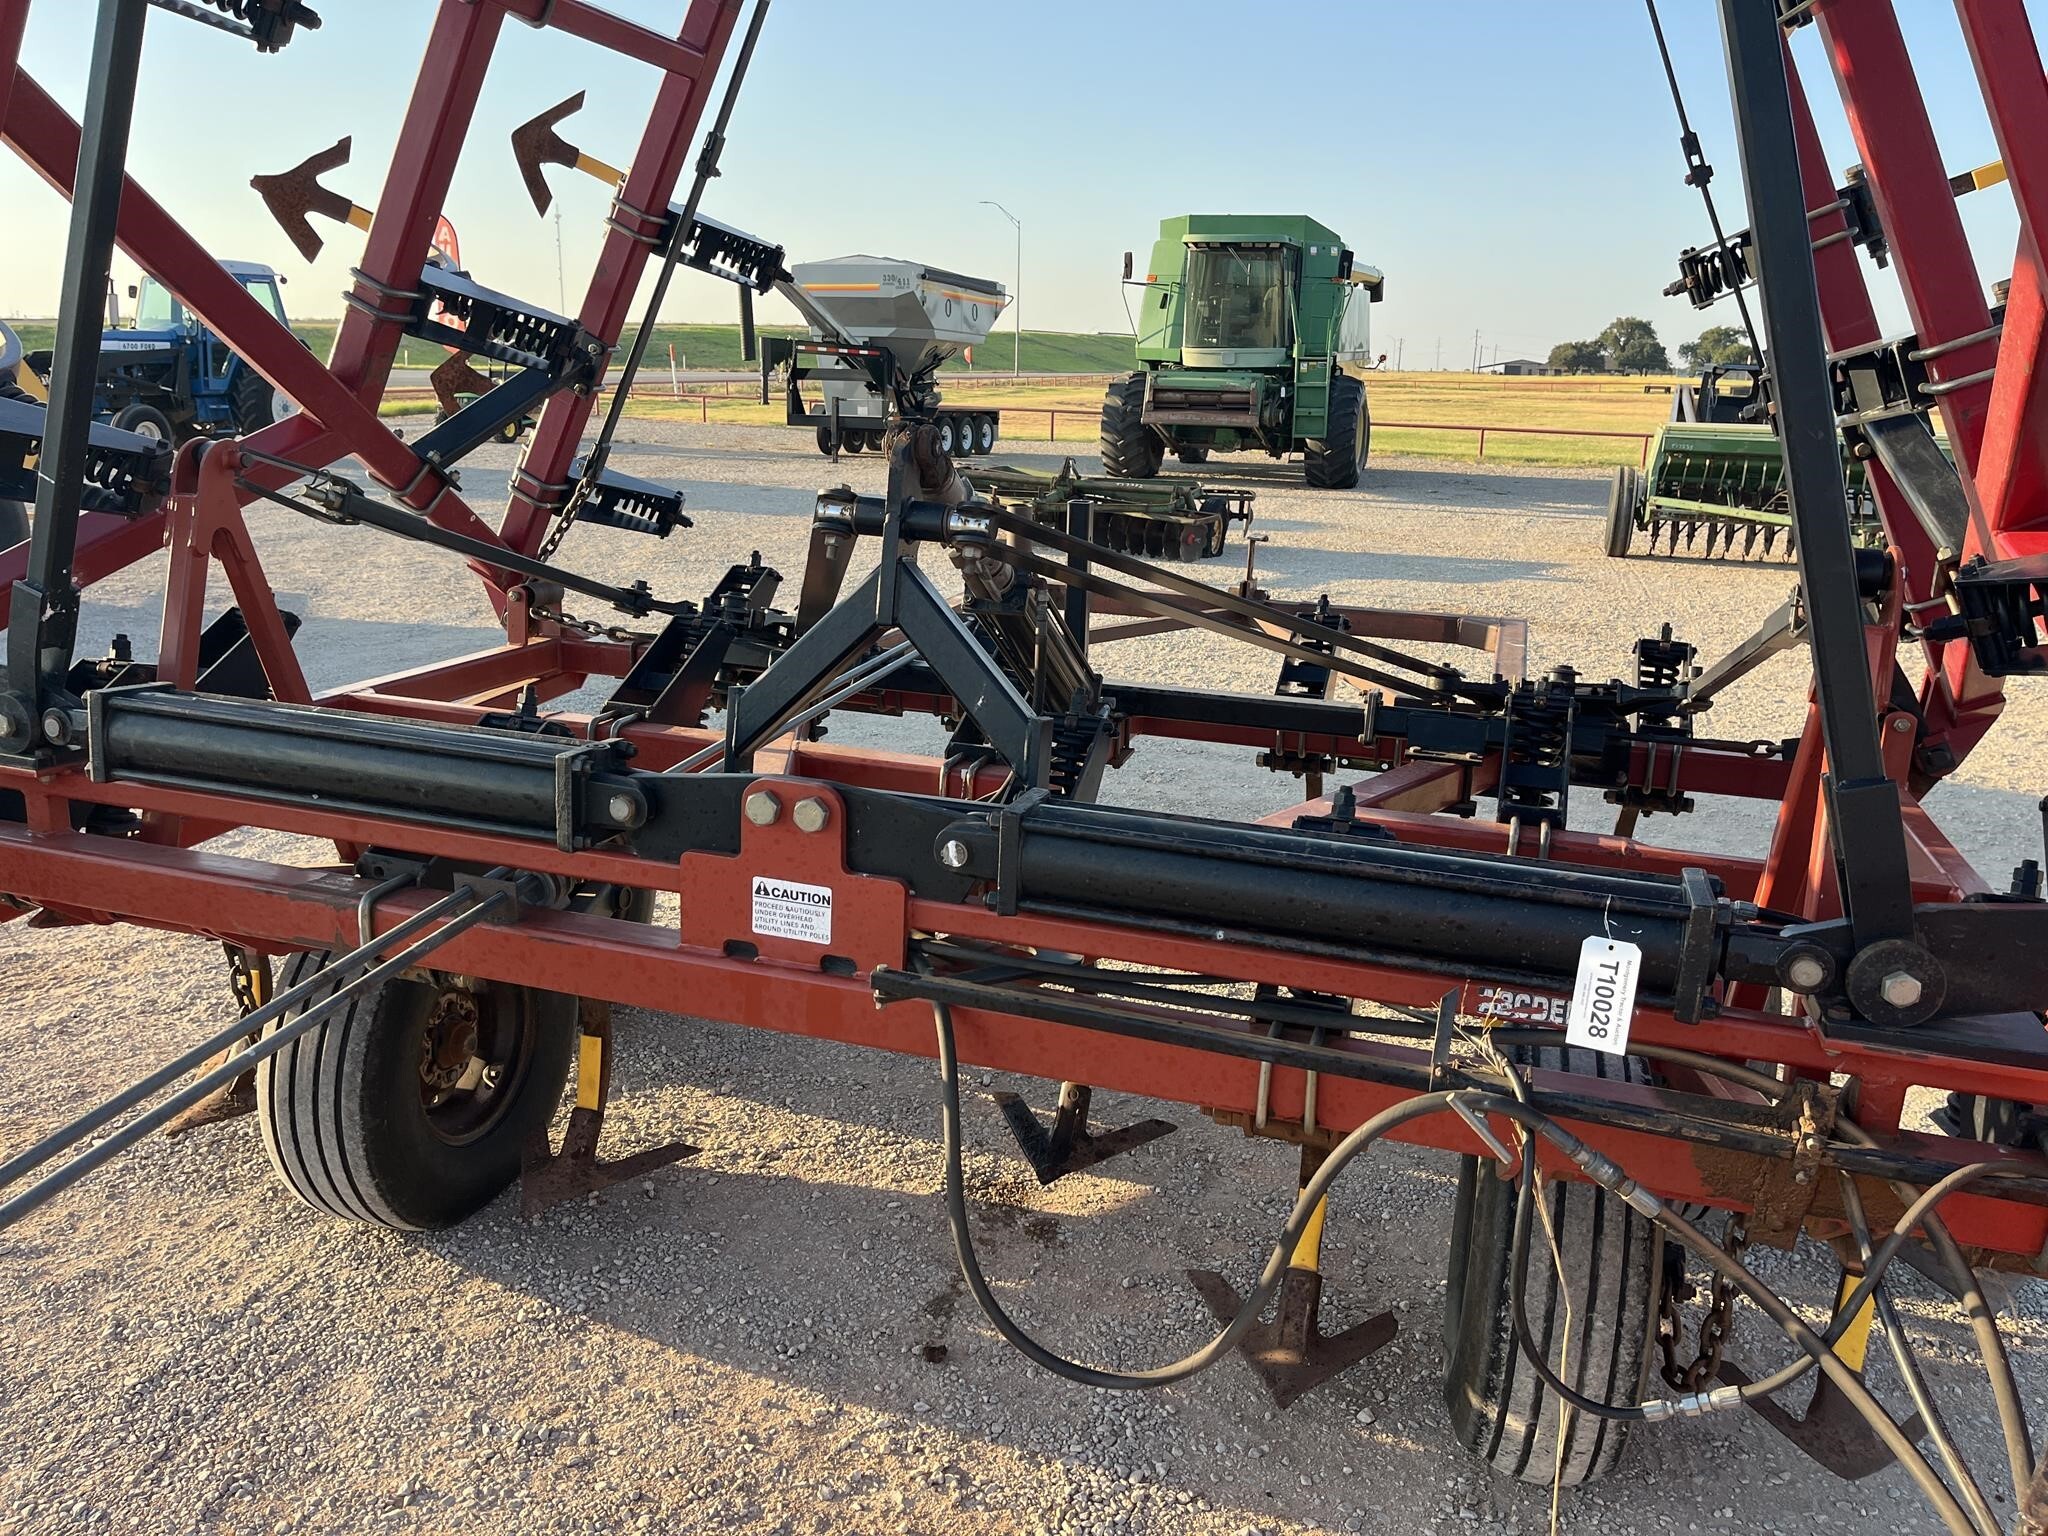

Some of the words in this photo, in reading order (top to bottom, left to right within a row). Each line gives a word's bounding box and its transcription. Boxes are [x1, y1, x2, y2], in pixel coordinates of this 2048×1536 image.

[771, 887, 831, 906] CAUTION
[754, 901, 784, 911] PROCEED
[754, 908, 777, 917] UNDER
[778, 912, 813, 923] OVERHEAD
[754, 916, 779, 926] UTILITY
[780, 919, 799, 928] LINES
[800, 923, 815, 931] AND
[754, 923, 782, 933] AROUND
[783, 928, 808, 937] UTILITY
[809, 932, 830, 941] POLES
[1588, 961, 1619, 1039] T10028
